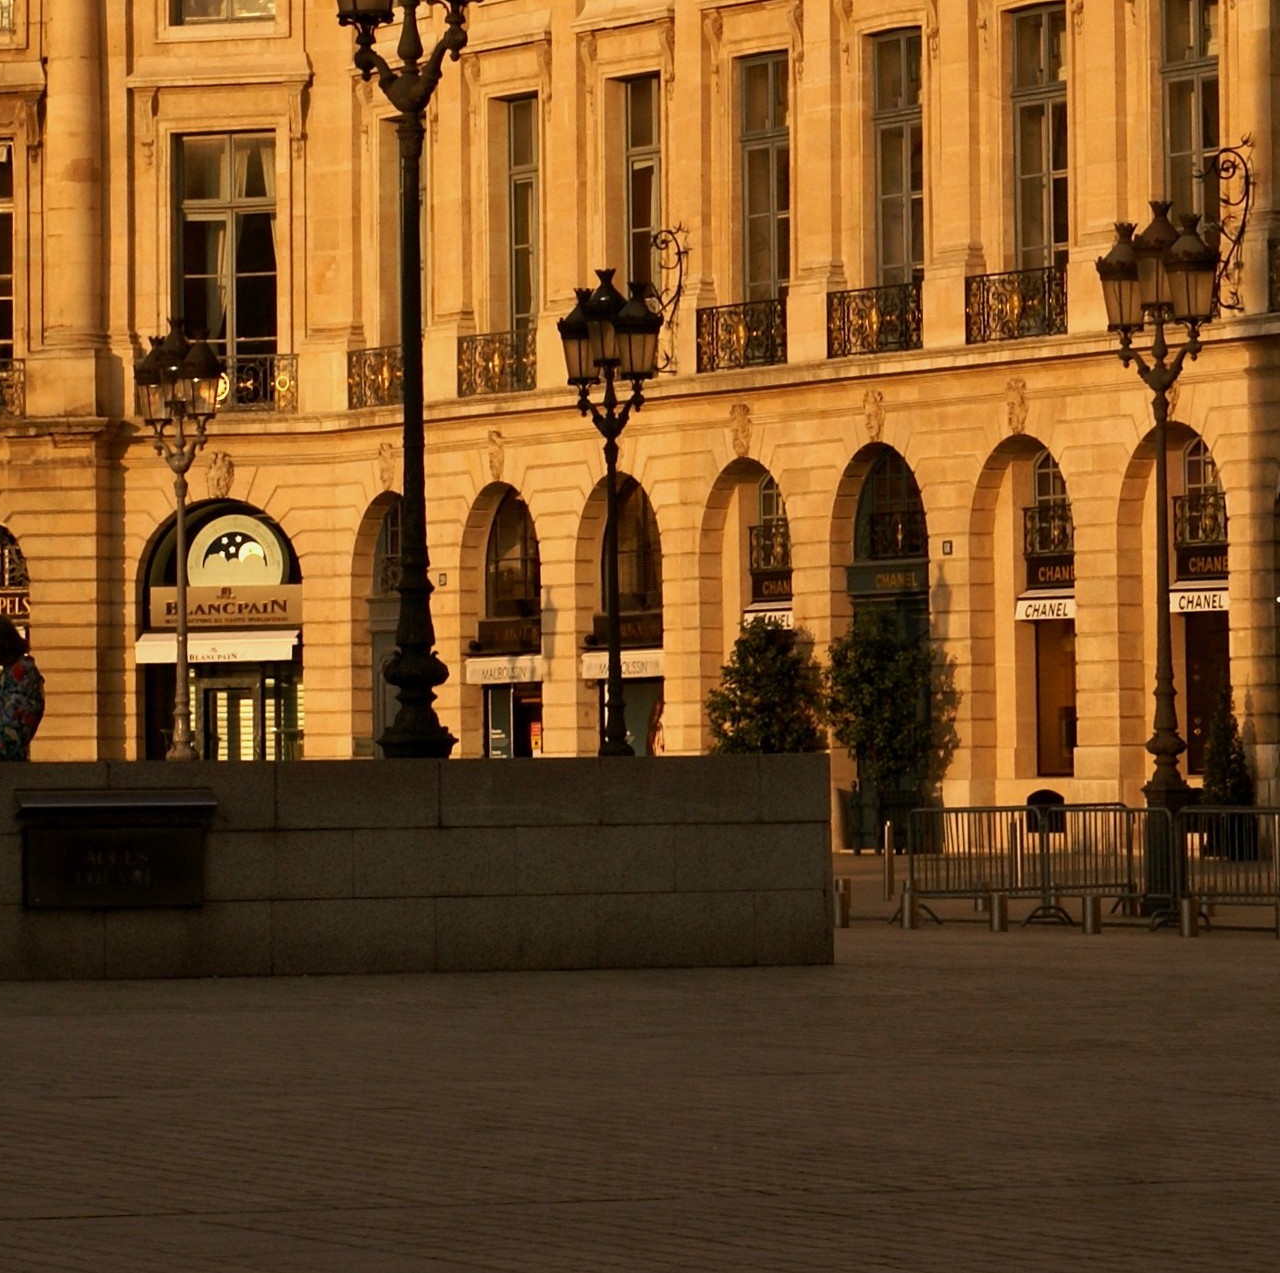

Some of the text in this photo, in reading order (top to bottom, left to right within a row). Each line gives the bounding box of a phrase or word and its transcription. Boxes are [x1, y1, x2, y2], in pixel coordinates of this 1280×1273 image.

[1188, 555, 1228, 573] CHANE
[875, 572, 917, 589] CHANEL
[1038, 565, 1074, 582] CHANE
[762, 577, 791, 595] CHAN
[165, 600, 287, 616] BANCPAIN
[1024, 602, 1068, 618] CHANEL
[1178, 594, 1224, 610] CHANEL
